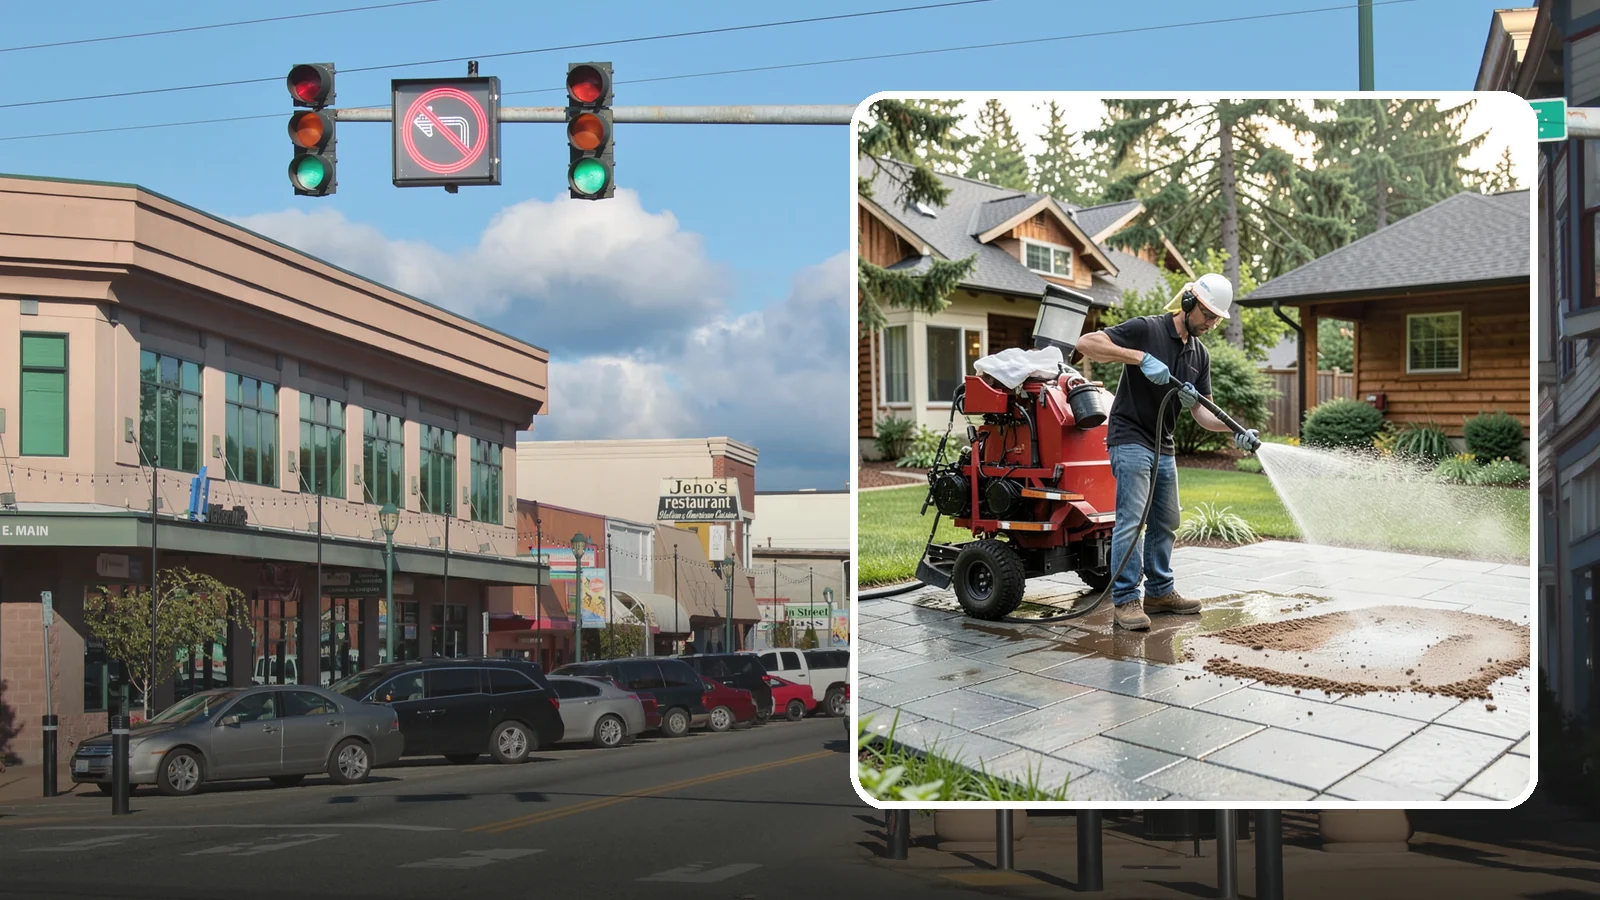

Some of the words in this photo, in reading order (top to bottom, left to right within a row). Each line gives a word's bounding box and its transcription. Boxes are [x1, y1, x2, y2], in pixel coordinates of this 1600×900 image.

[670, 480, 727, 494] Jeno's
[665, 496, 731, 509] restaurant
[658, 510, 681, 519] Italian
[686, 510, 714, 519] American
[715, 509, 737, 519] Cuisine
[2, 525, 13, 536] E.
[15, 525, 49, 536] MAIN
[797, 608, 828, 616] Street
